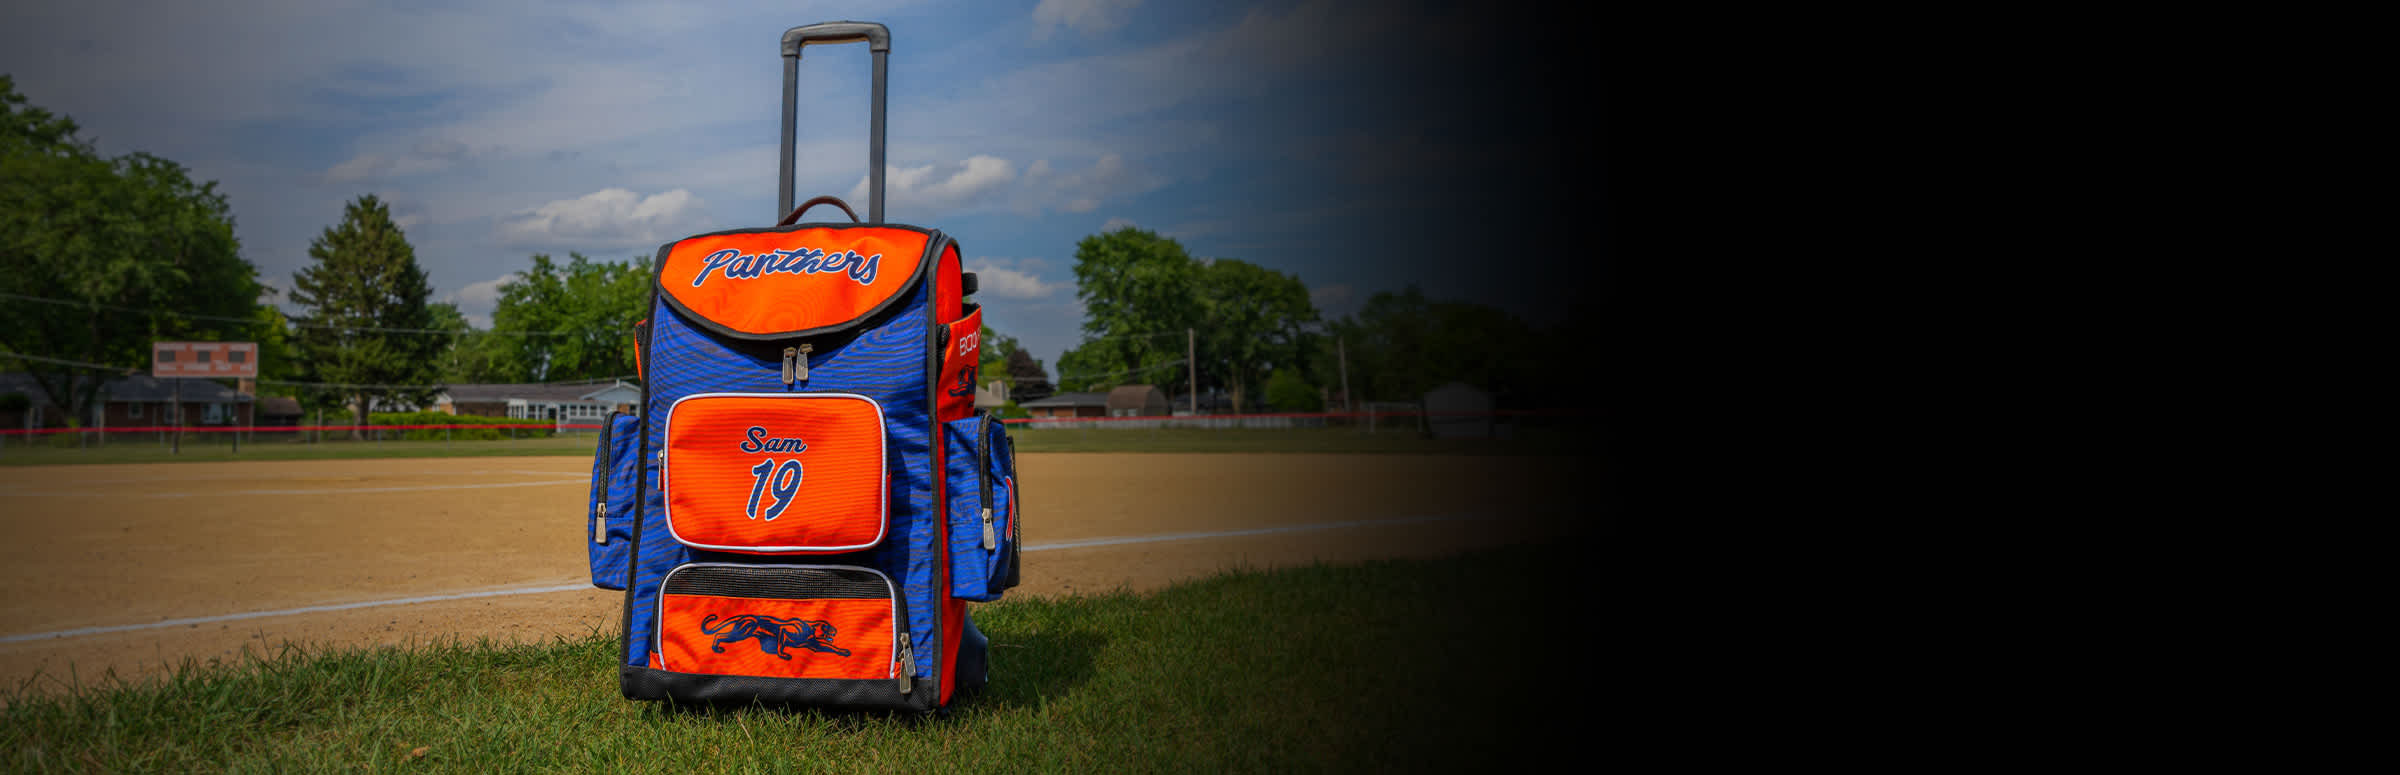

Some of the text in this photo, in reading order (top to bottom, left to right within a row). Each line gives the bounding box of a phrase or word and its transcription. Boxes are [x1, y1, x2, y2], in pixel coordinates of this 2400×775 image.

[692, 247, 882, 286] Panthers
[740, 426, 807, 453] Sam
[746, 458, 803, 521] 19
